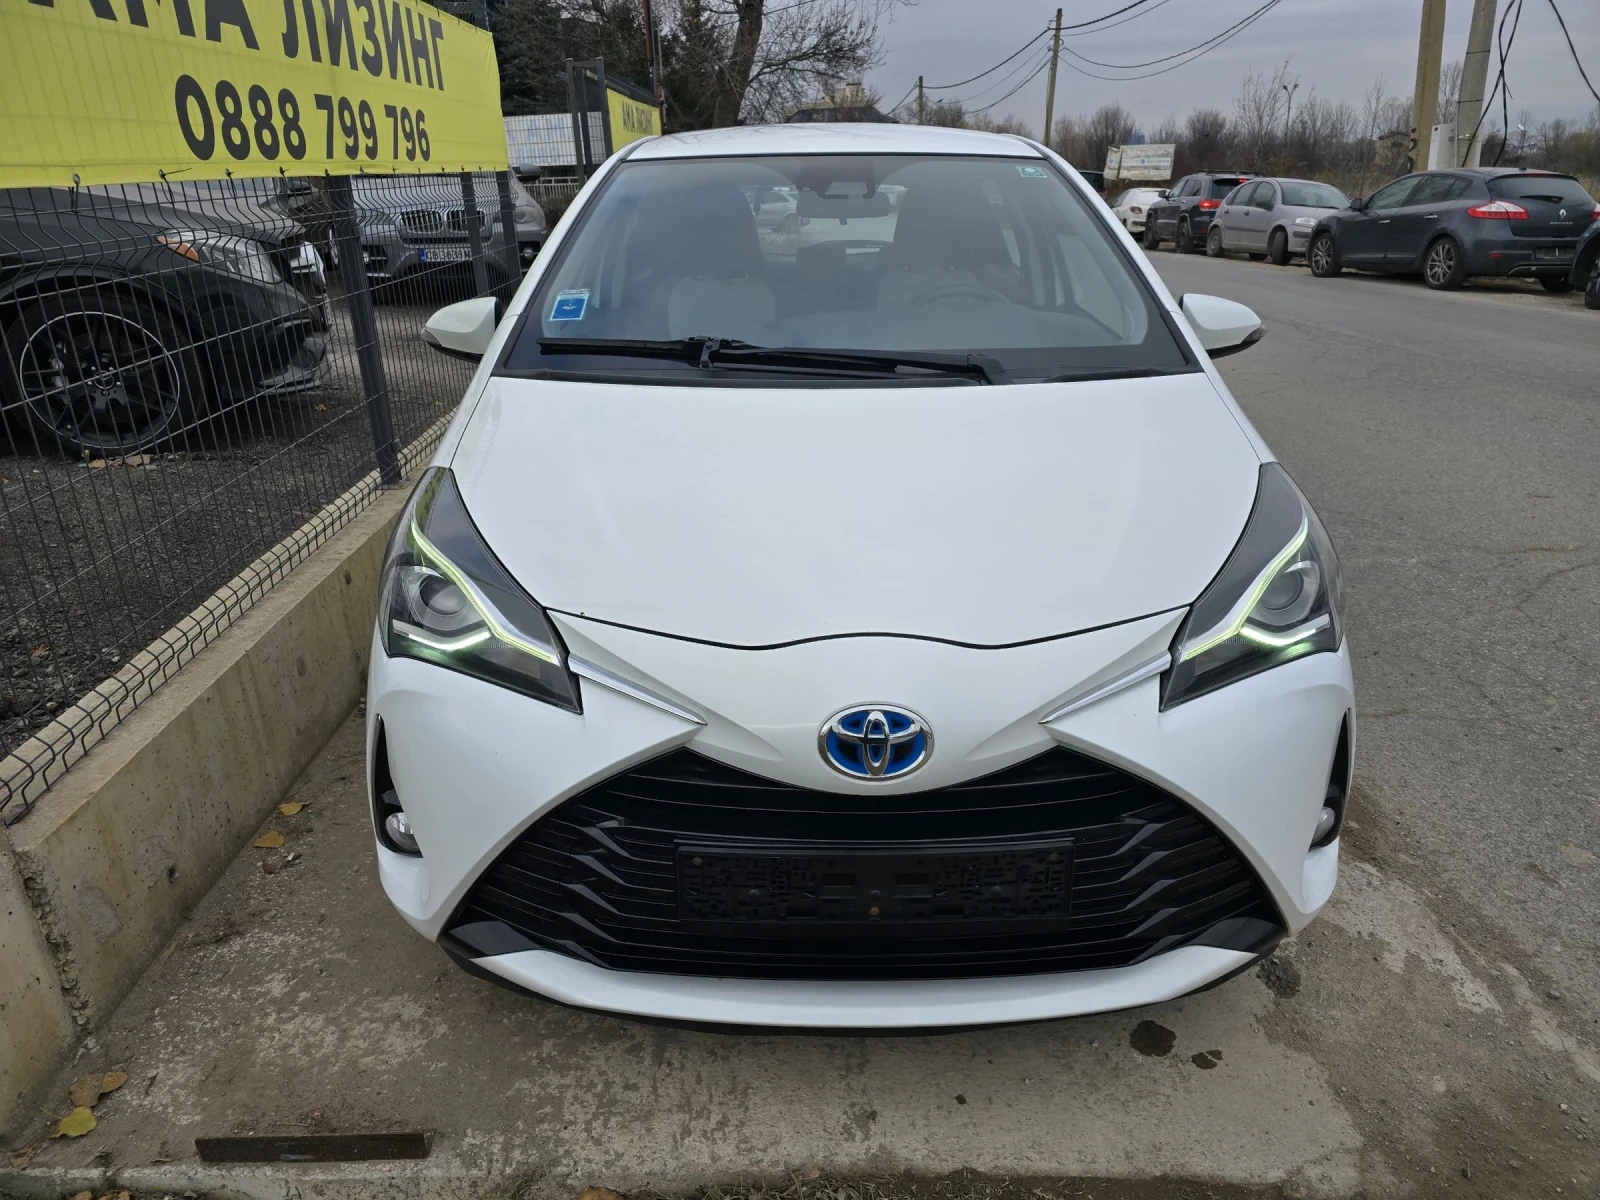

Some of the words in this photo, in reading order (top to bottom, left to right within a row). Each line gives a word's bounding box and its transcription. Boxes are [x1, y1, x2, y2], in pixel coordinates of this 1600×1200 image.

[281, 0, 444, 91] ЛИЗИНГ
[174, 74, 306, 161] 0888
[314, 93, 378, 160] 799
[385, 105, 431, 162] 796
